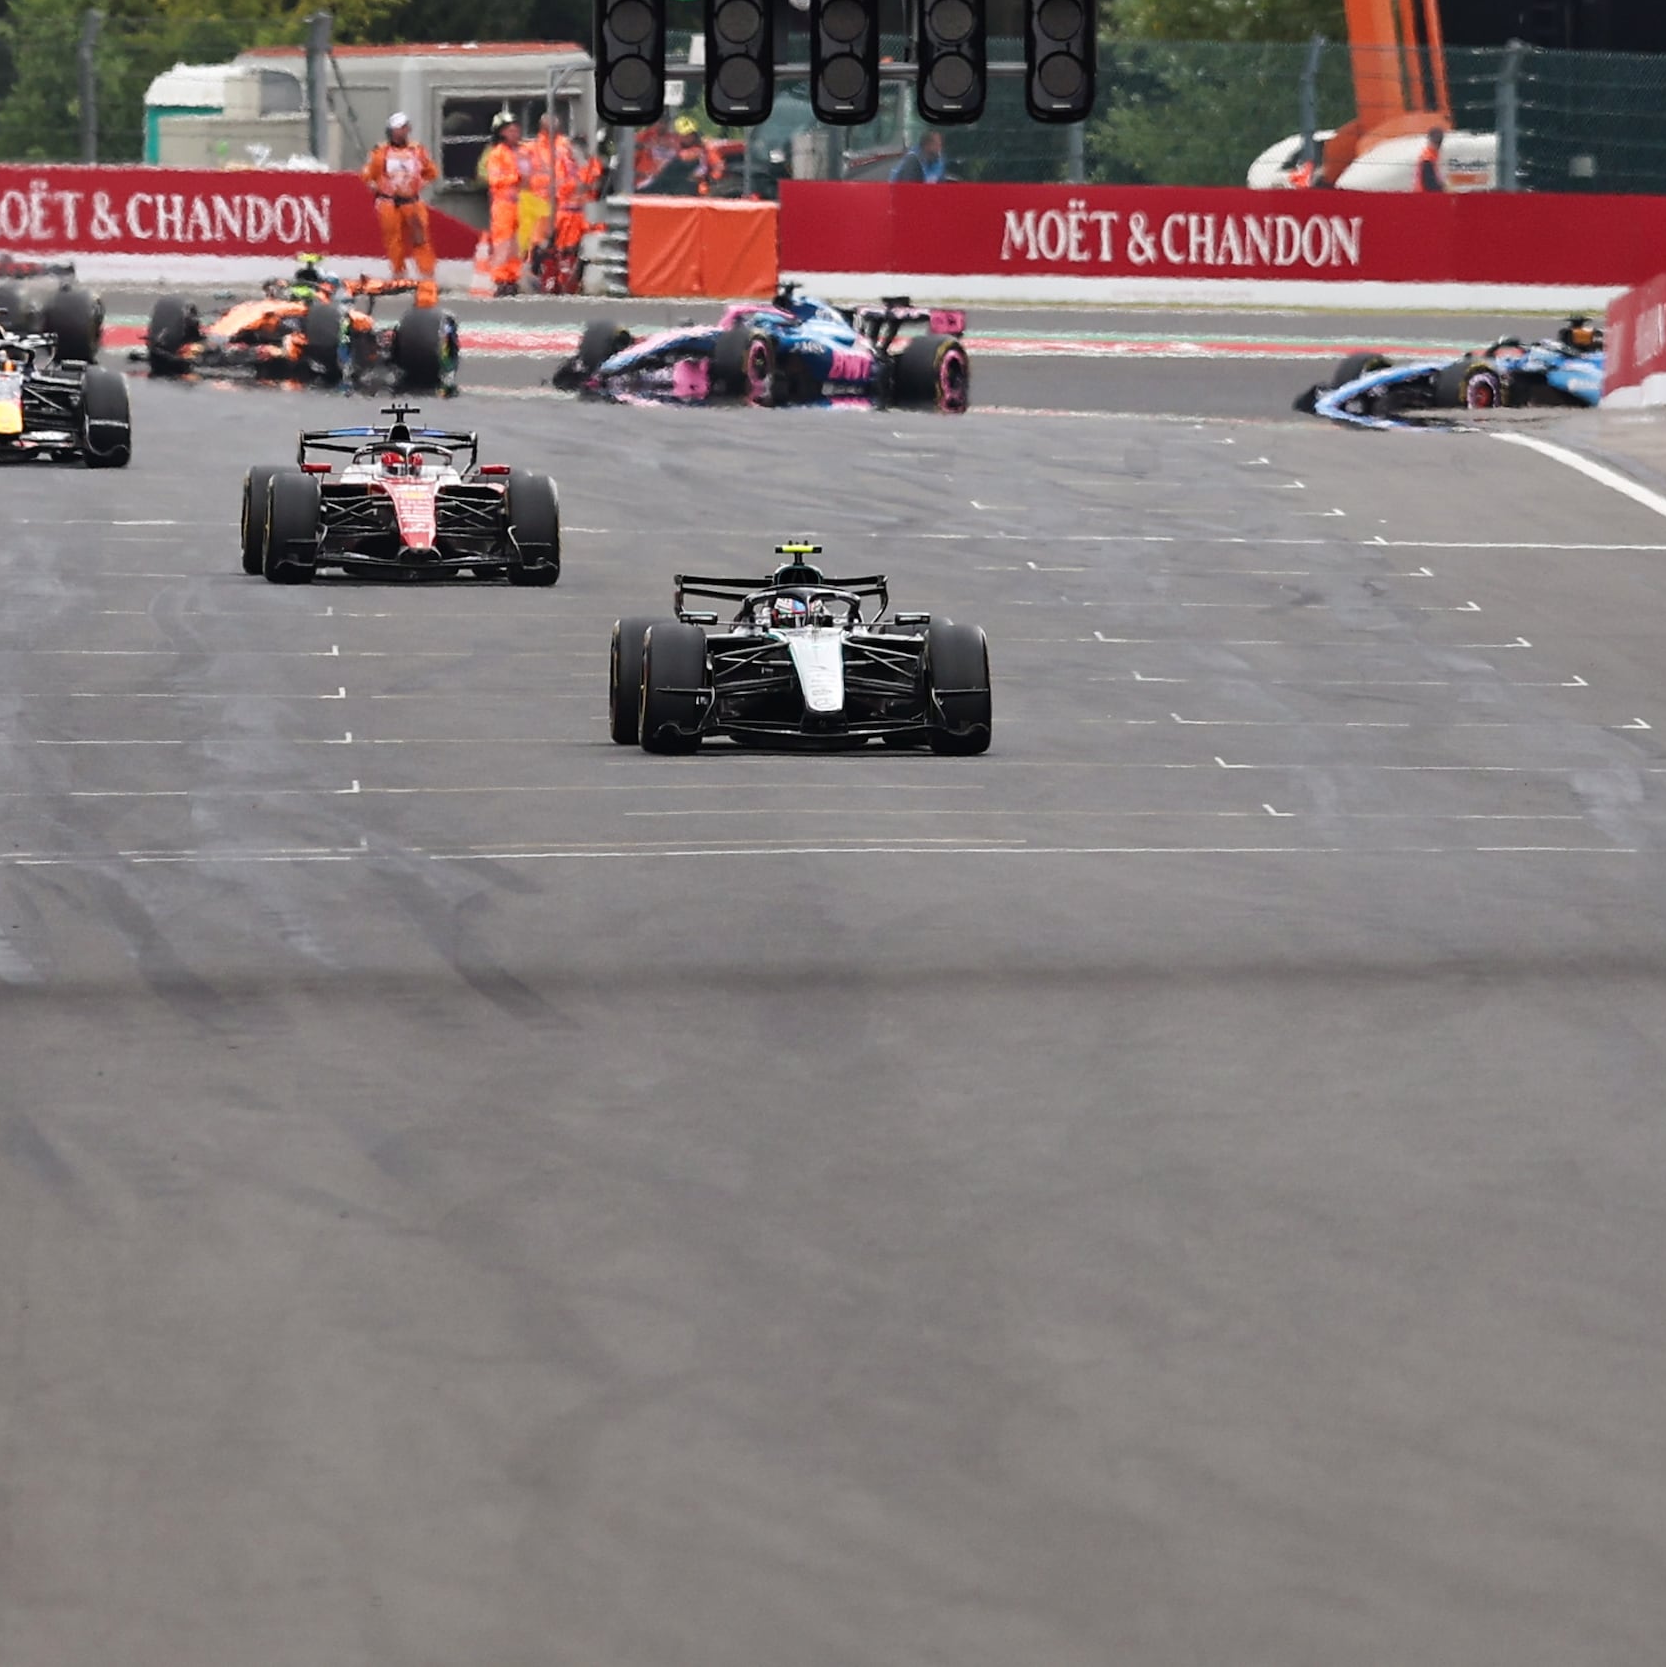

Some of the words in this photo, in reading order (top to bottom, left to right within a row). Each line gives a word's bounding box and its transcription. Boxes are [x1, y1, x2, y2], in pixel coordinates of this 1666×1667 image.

[90, 190, 122, 242] &
[126, 192, 331, 245] CHANDON
[1000, 198, 1118, 262] MOËT
[1127, 210, 1157, 265] &
[1161, 212, 1363, 268] CHANDON
